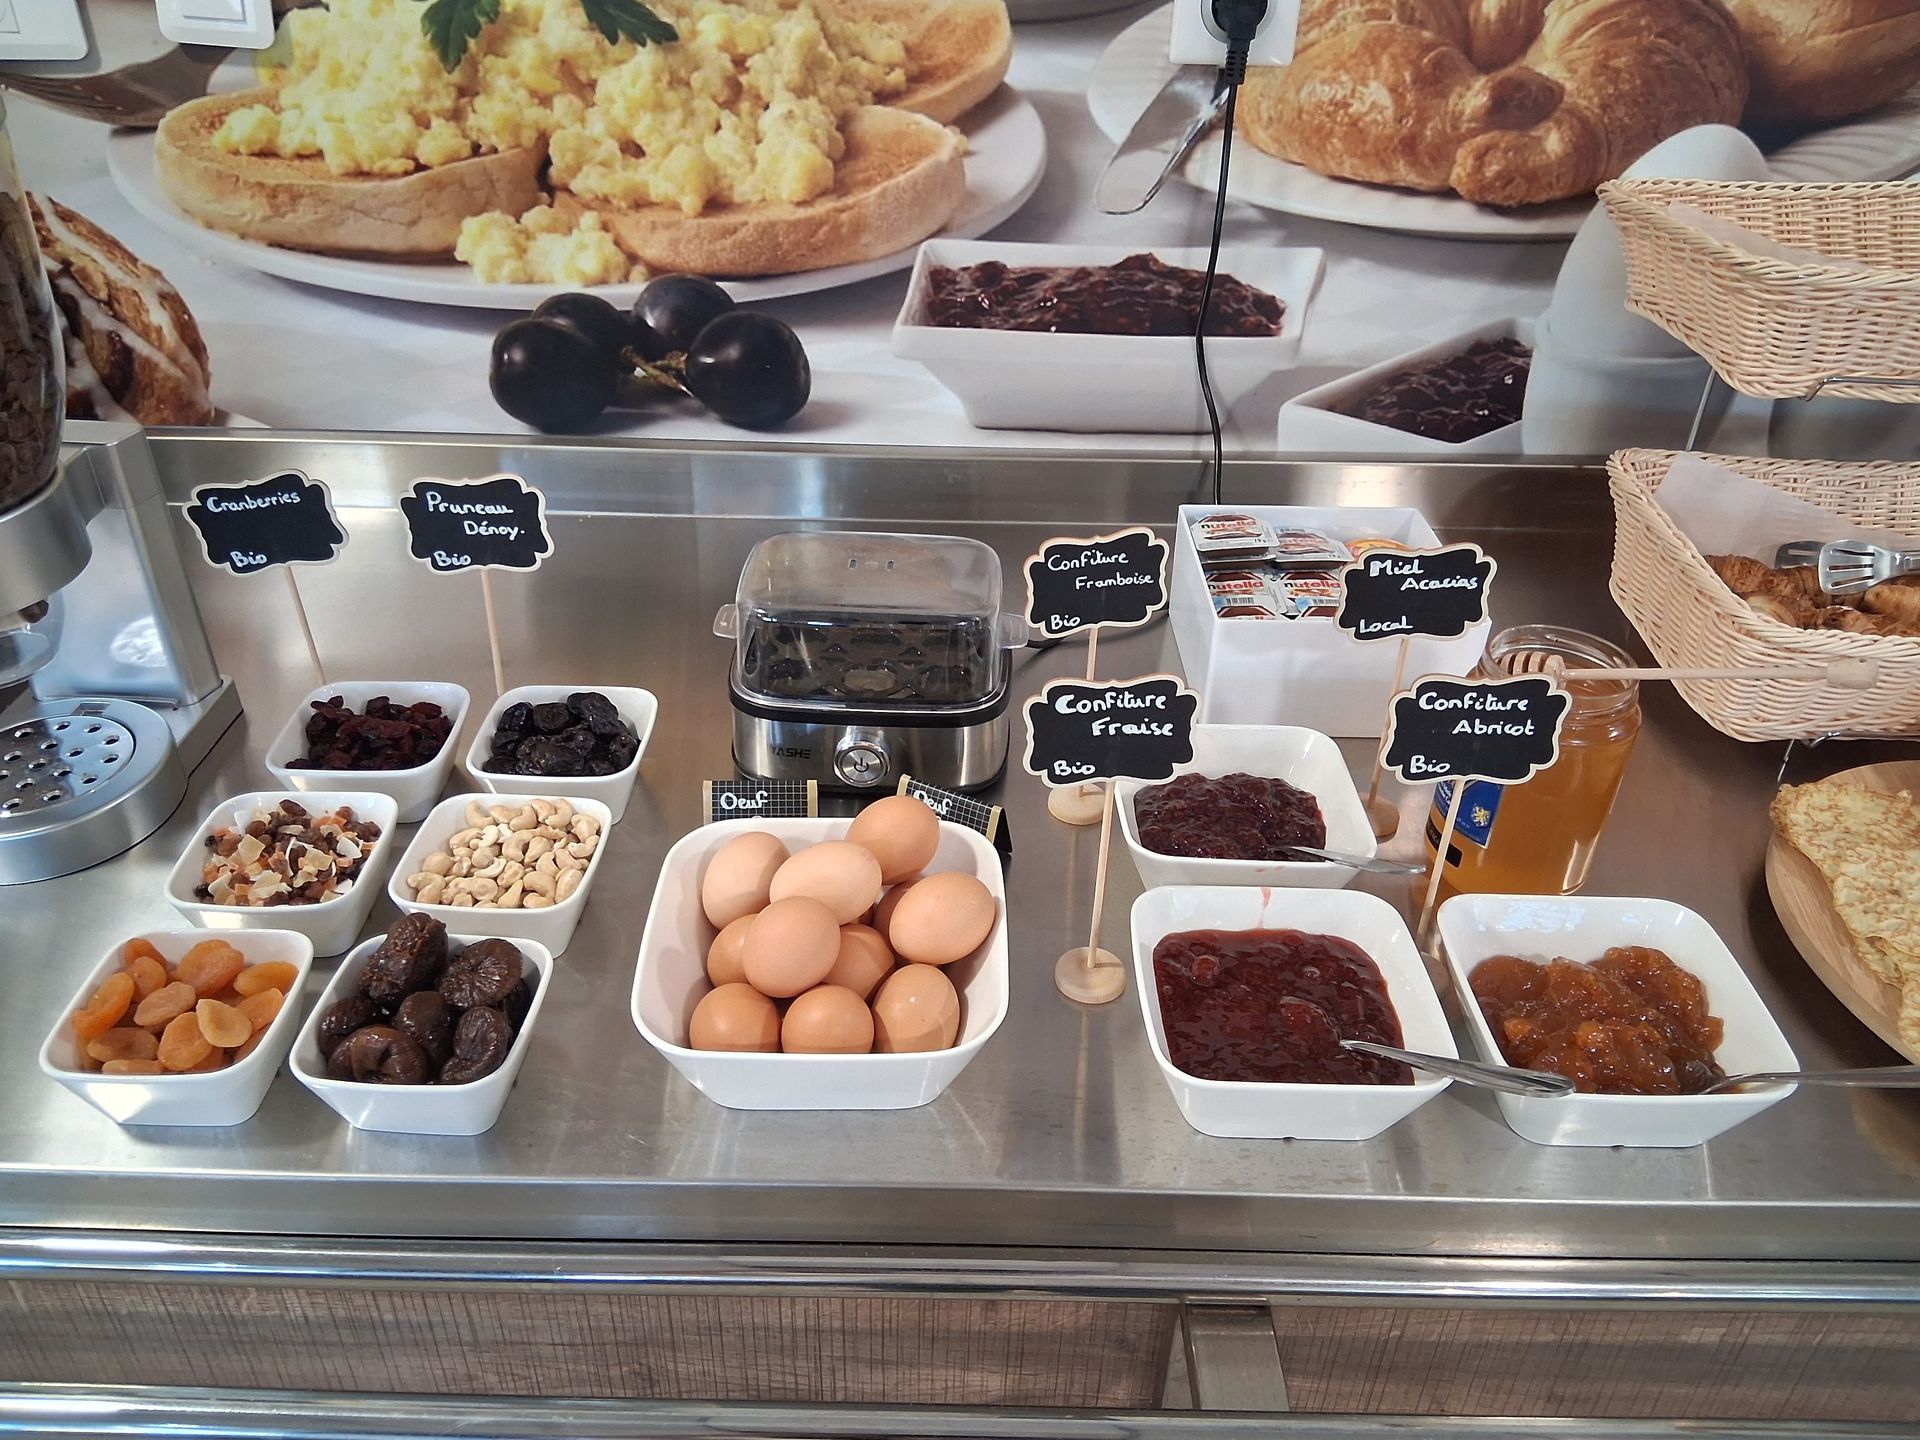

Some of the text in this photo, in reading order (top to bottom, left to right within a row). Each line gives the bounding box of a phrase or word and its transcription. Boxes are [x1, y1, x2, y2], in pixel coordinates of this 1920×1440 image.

[206, 491, 302, 514] Cranberries
[426, 491, 515, 516] Pruneau
[463, 519, 527, 540] Dénoy.
[231, 550, 268, 569] Bio
[434, 550, 473, 568] Bio
[1047, 549, 1130, 572] Confiture
[1369, 559, 1425, 578] Miel
[1075, 571, 1155, 591] Framboise
[1207, 580, 1264, 592] nutella
[1283, 580, 1342, 590] nutella
[1400, 575, 1479, 592] Acacias
[1050, 613, 1081, 631] Bio
[1359, 615, 1414, 634] Local
[1054, 690, 1167, 716] Confiture
[1418, 691, 1529, 712] Confiture
[1091, 716, 1174, 737] Fraise
[1451, 718, 1536, 736] Abricot
[1053, 759, 1096, 776] Bio
[1410, 754, 1451, 774] Bio
[720, 790, 768, 809] Oeuf
